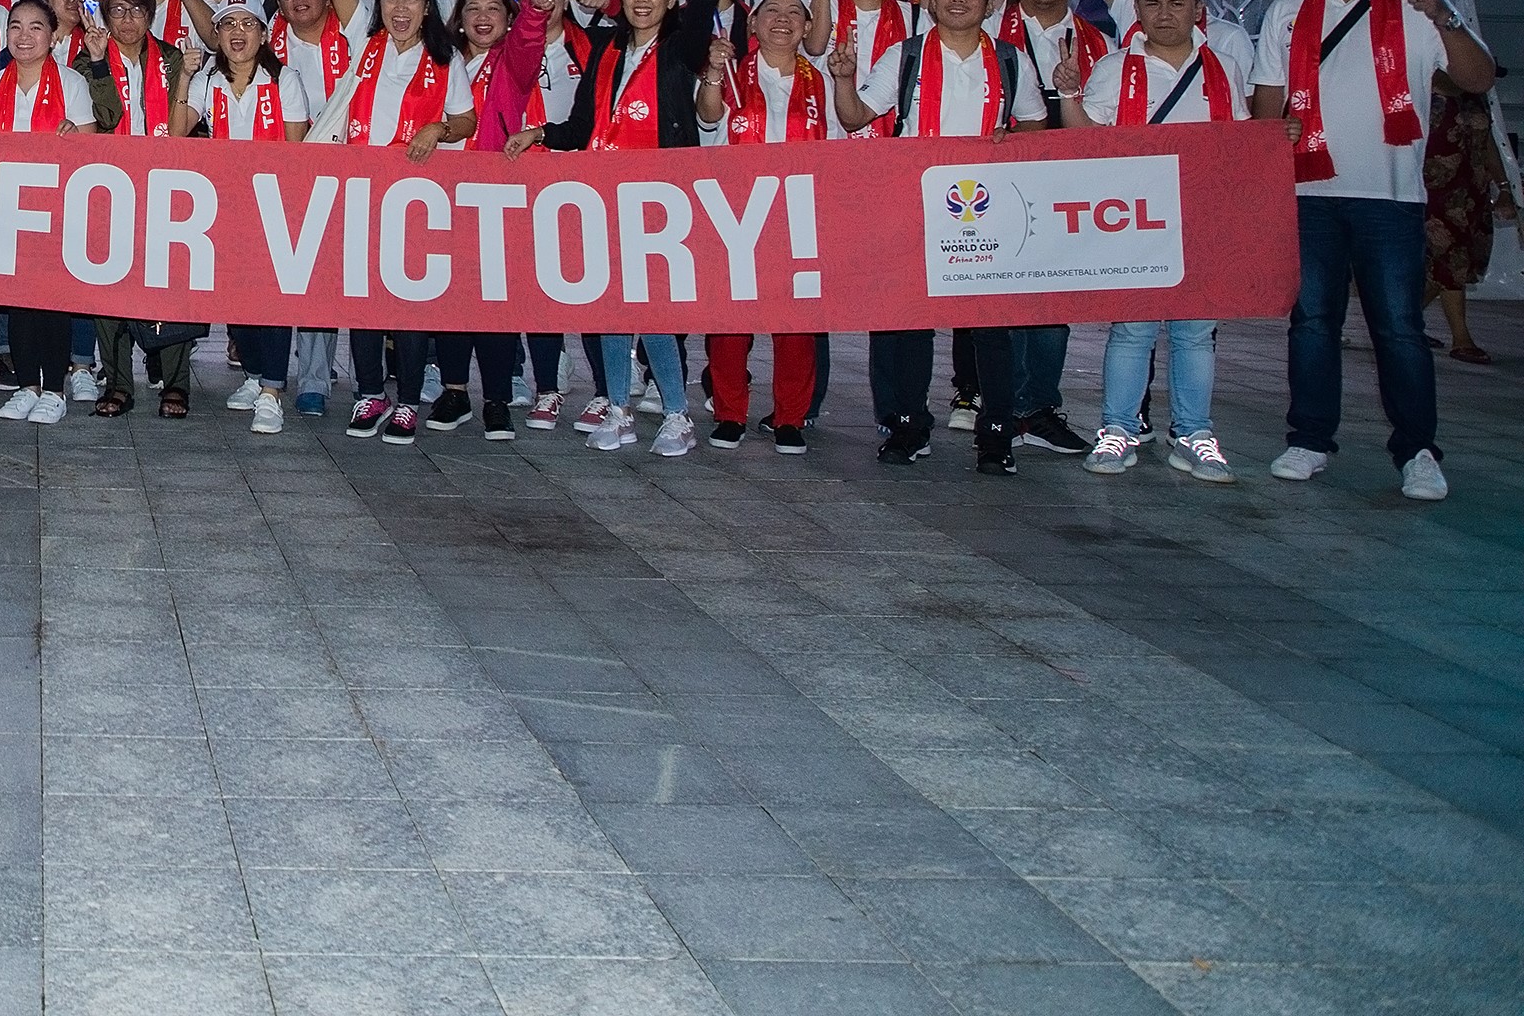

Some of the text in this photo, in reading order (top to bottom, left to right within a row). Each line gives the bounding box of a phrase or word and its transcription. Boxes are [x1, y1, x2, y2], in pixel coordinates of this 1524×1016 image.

[274, 31, 285, 59] TCL
[329, 40, 340, 74] TCL
[360, 48, 379, 81] TCL
[747, 54, 757, 85] TCL
[260, 89, 274, 130] TCL
[805, 95, 819, 130] TCL
[1053, 198, 1167, 234] TCL
[252, 173, 823, 305] VICTORY!
[940, 243, 1000, 253] WORLD CUP
[942, 265, 1169, 282] GLOBAL PARTNER OF FIBA BASKETBALL WORLD CUP 2019
[948, 254, 994, 264] China 2019
